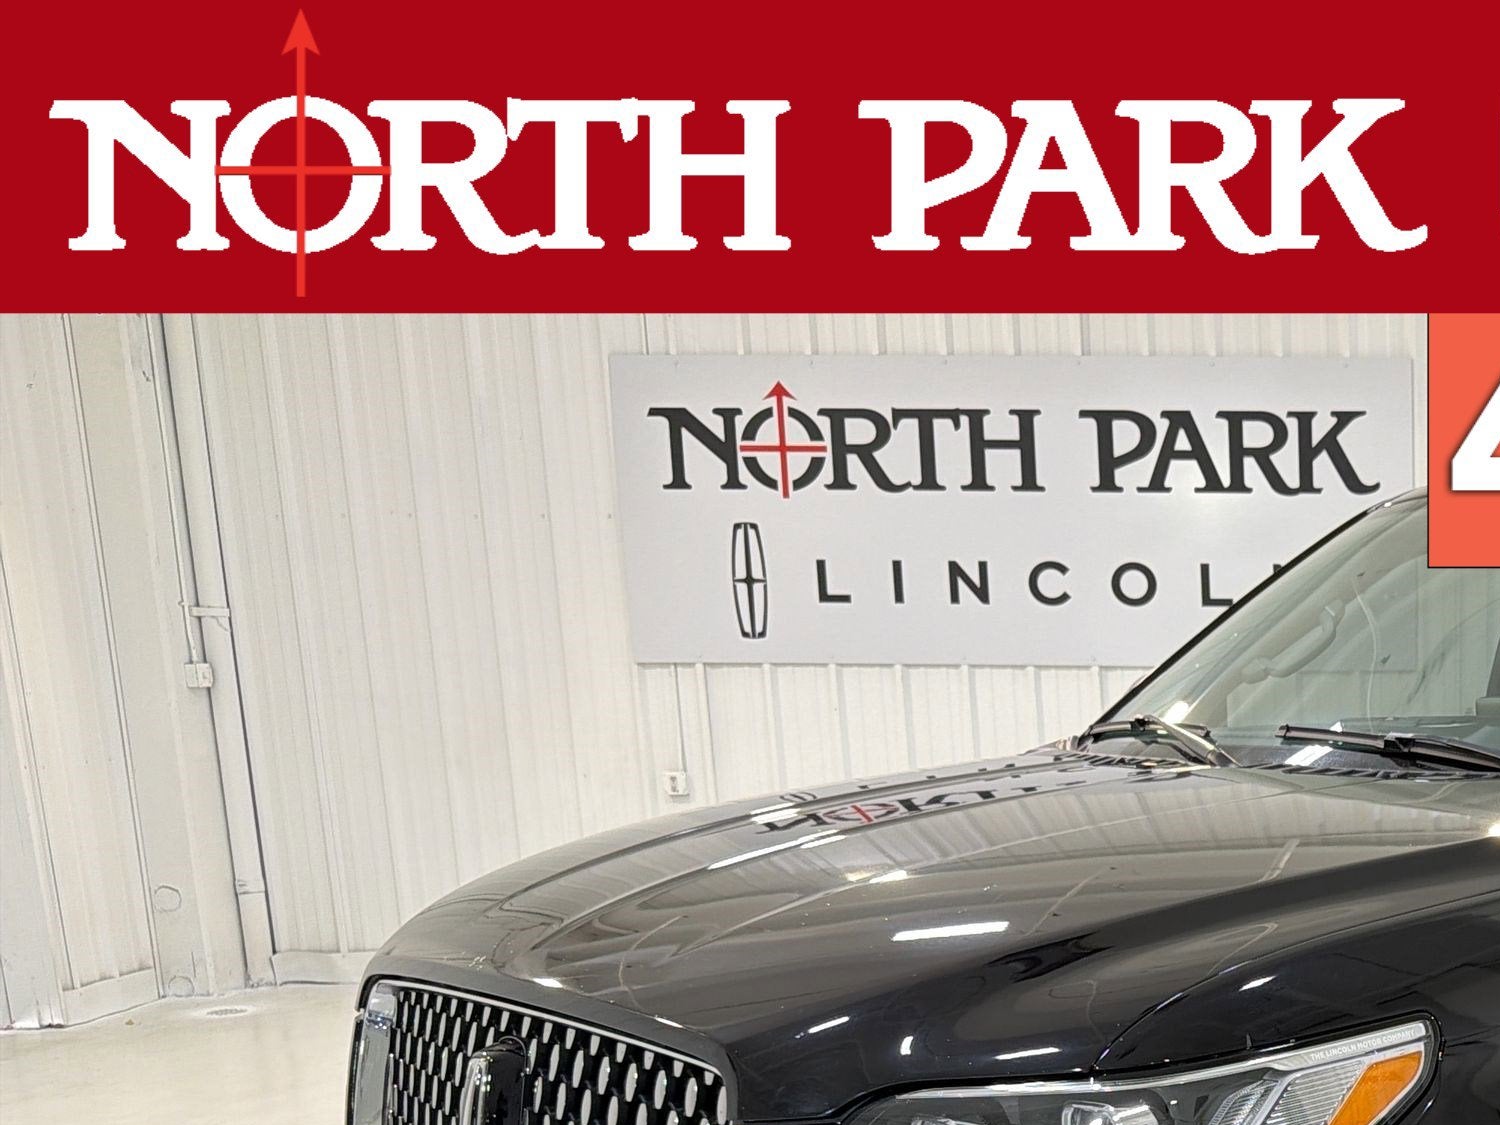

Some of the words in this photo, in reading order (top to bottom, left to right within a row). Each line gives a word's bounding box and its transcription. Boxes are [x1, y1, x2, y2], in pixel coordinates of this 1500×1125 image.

[648, 406, 1046, 493] NORTH
[1079, 409, 1382, 497] PARK
[815, 559, 1283, 607] LINCOL
[1310, 1052, 1324, 1061] THE
[1326, 1043, 1356, 1057] LINCOLN
[1357, 1037, 1382, 1050] MOTOR
[1383, 1029, 1415, 1043] COMPANY
